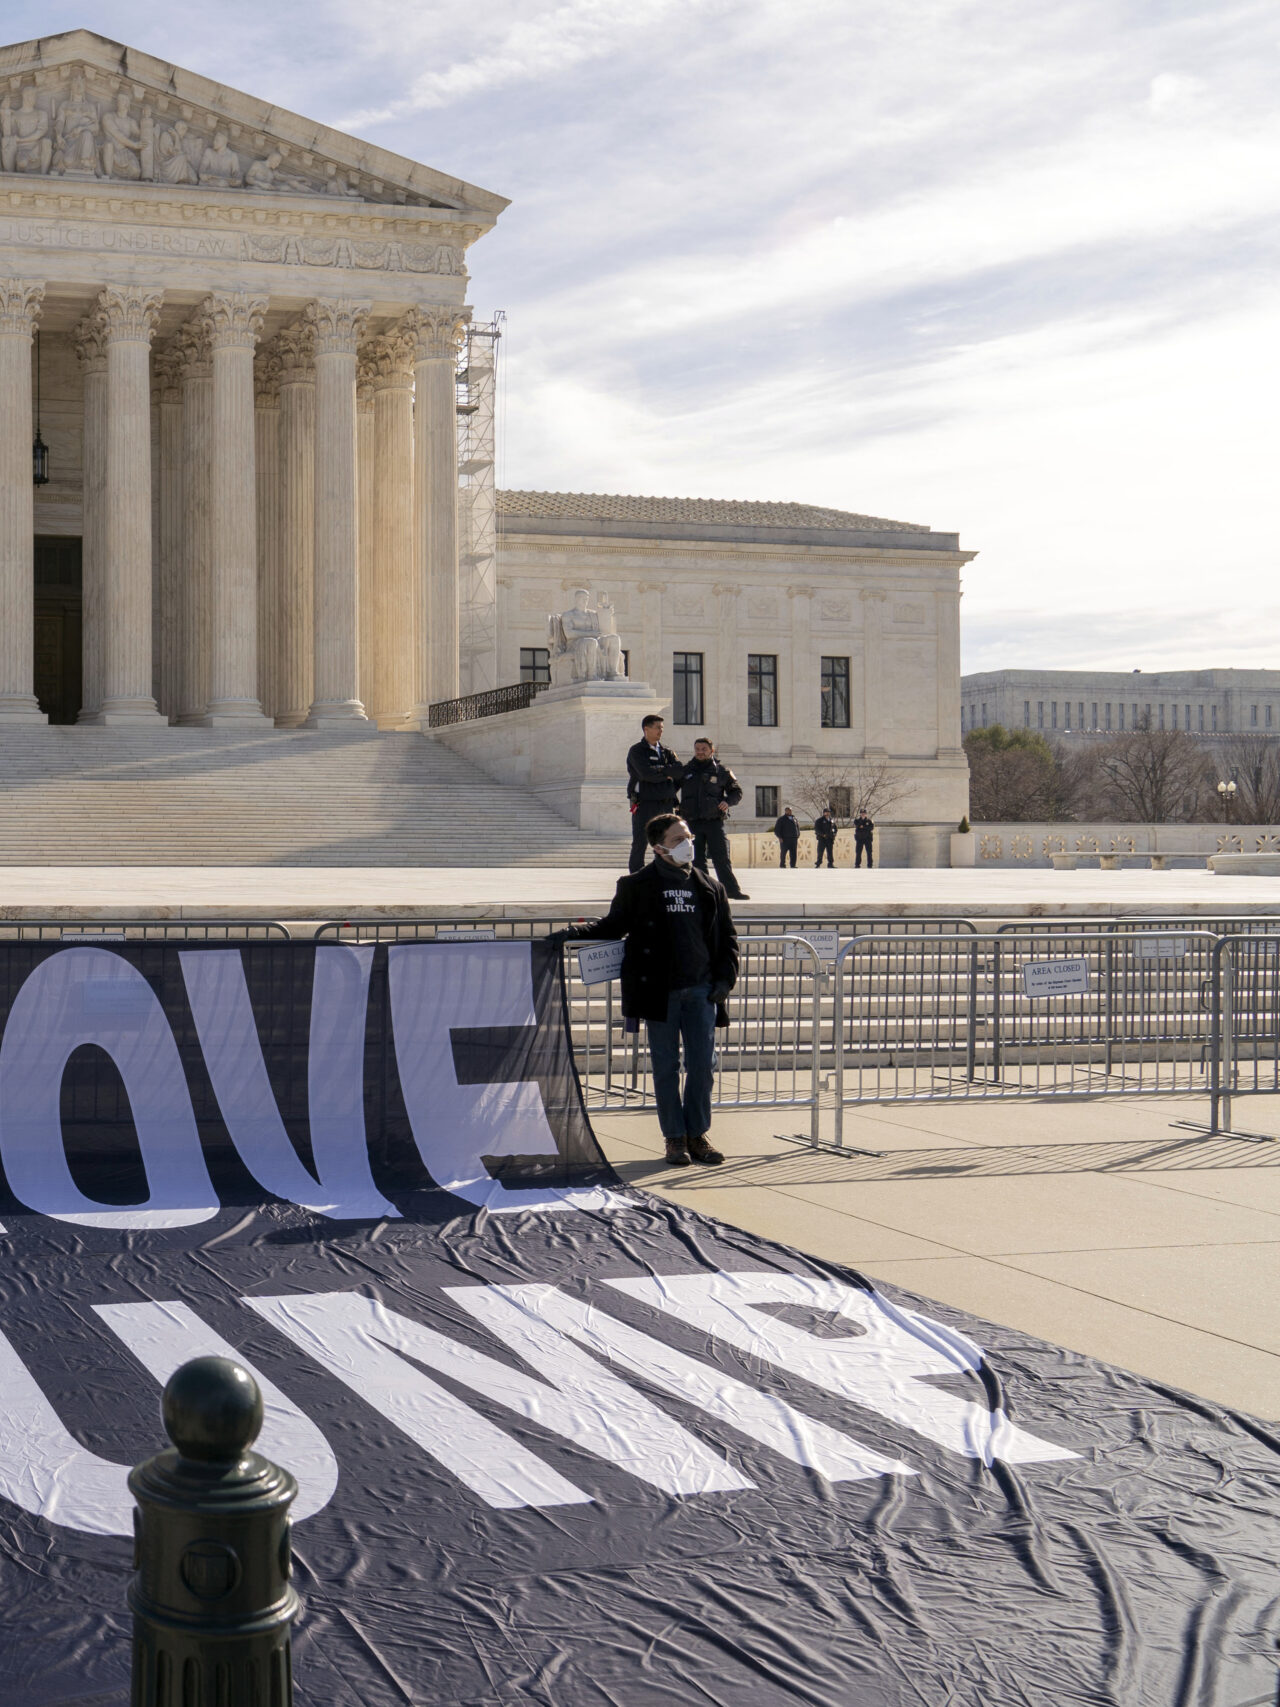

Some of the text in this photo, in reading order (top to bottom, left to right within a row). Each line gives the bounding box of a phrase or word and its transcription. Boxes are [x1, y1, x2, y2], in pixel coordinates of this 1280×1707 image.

[2, 224, 90, 247] JUSTICE
[102, 230, 174, 251] UNDER
[185, 236, 226, 254] LAW
[662, 889, 693, 898] TRUMP
[674, 897, 685, 905] IS
[587, 950, 610, 961] AREA
[1031, 964, 1081, 976] AREA CLOSED
